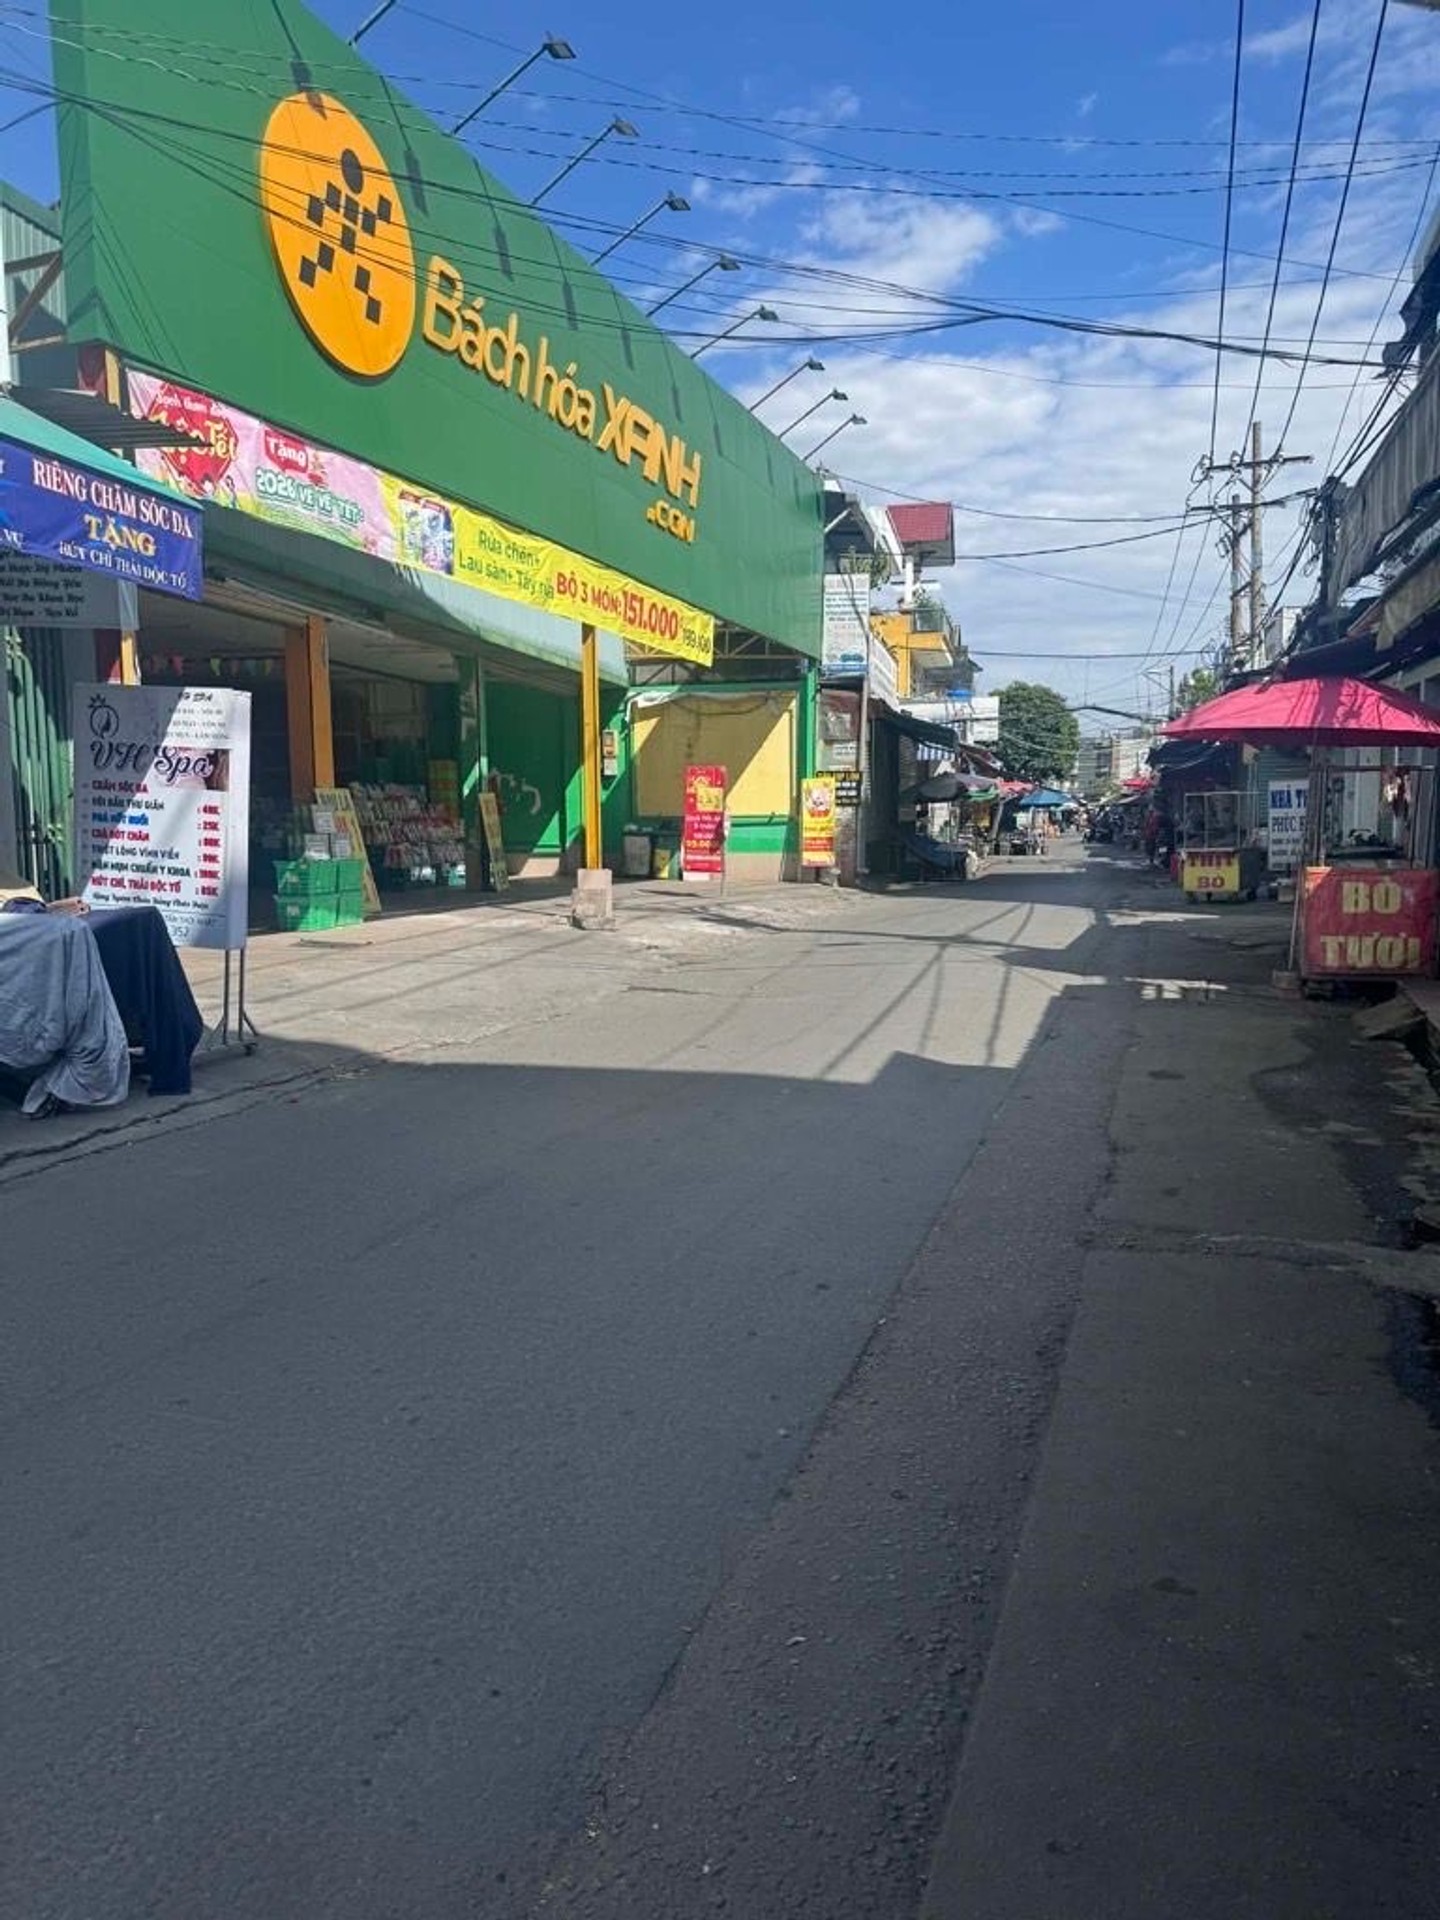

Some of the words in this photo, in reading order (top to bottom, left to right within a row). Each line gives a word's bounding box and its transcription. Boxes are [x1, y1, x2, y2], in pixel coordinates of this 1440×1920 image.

[423, 255, 531, 399] Bách
[535, 336, 596, 441] hóa
[597, 381, 701, 508] XANH
[266, 437, 306, 468] Tặng
[33, 459, 87, 501] RIÊNG
[91, 481, 137, 519] CHĂM
[139, 498, 170, 532] SÓC
[172, 512, 194, 538] DA
[257, 469, 296, 499] 2026
[84, 514, 157, 556] TẶNG
[90, 550, 112, 568] CHÌ
[459, 548, 483, 574] Lau
[556, 571, 578, 602] BỘ
[581, 583, 588, 603] 3
[622, 590, 678, 640] 151.000
[153, 746, 214, 784] Spa
[1342, 876, 1401, 914] BÒ
